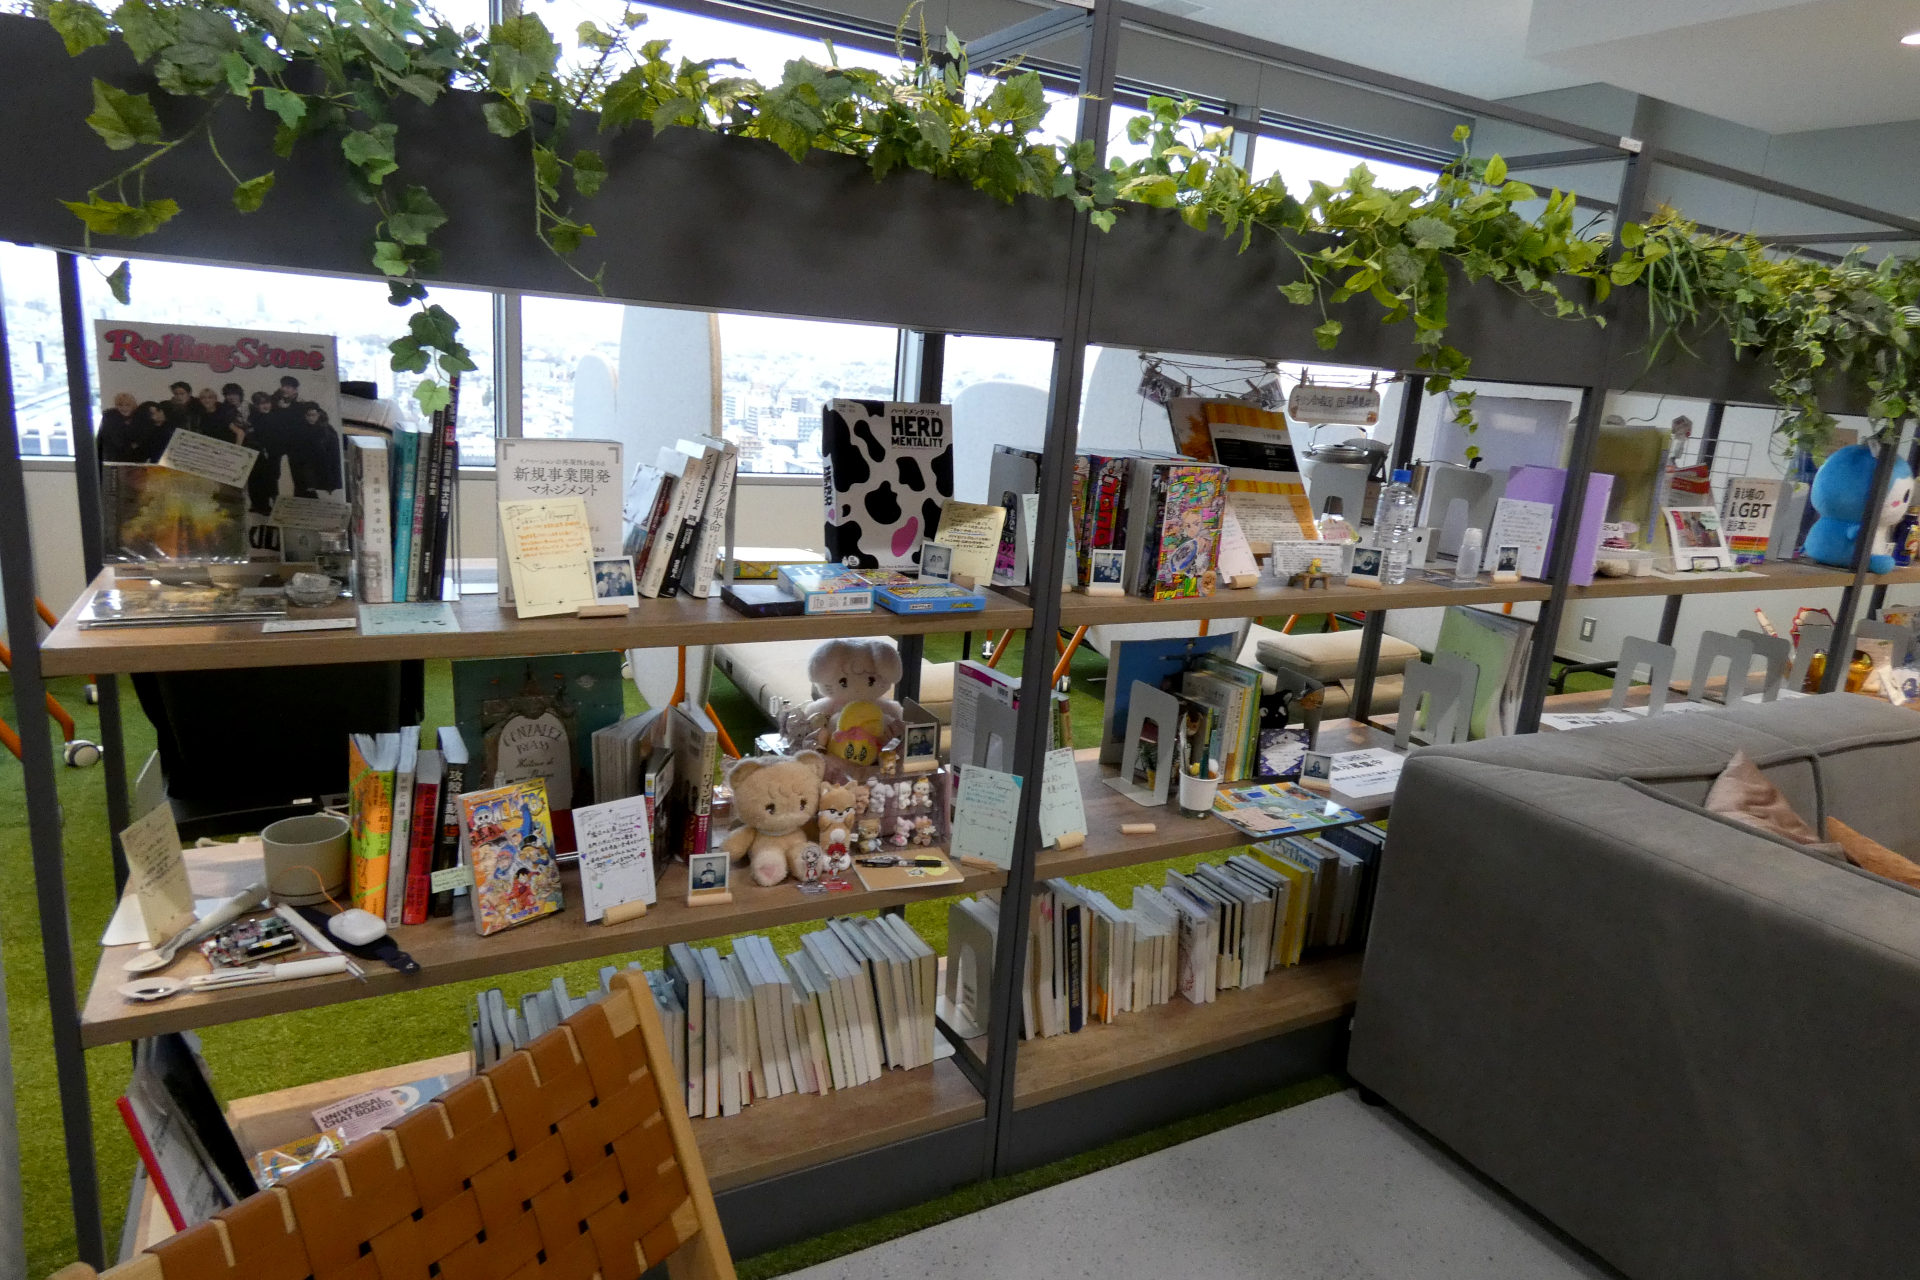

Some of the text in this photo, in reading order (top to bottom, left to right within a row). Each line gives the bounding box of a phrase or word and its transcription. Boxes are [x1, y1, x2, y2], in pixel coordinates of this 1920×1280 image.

[891, 416, 944, 437] HERD
[891, 437, 943, 448] MENTALITY
[513, 466, 611, 484] 新規事業開発
[693, 453, 714, 511] イシューからはじめよ
[527, 484, 598, 497] マネジメント
[709, 452, 735, 534] フードテック革命
[1729, 502, 1772, 518] LGBT
[1272, 838, 1318, 872] Python
[320, 1097, 384, 1123] UNIVERSAL
[323, 1100, 394, 1129] CHAT BOARD
